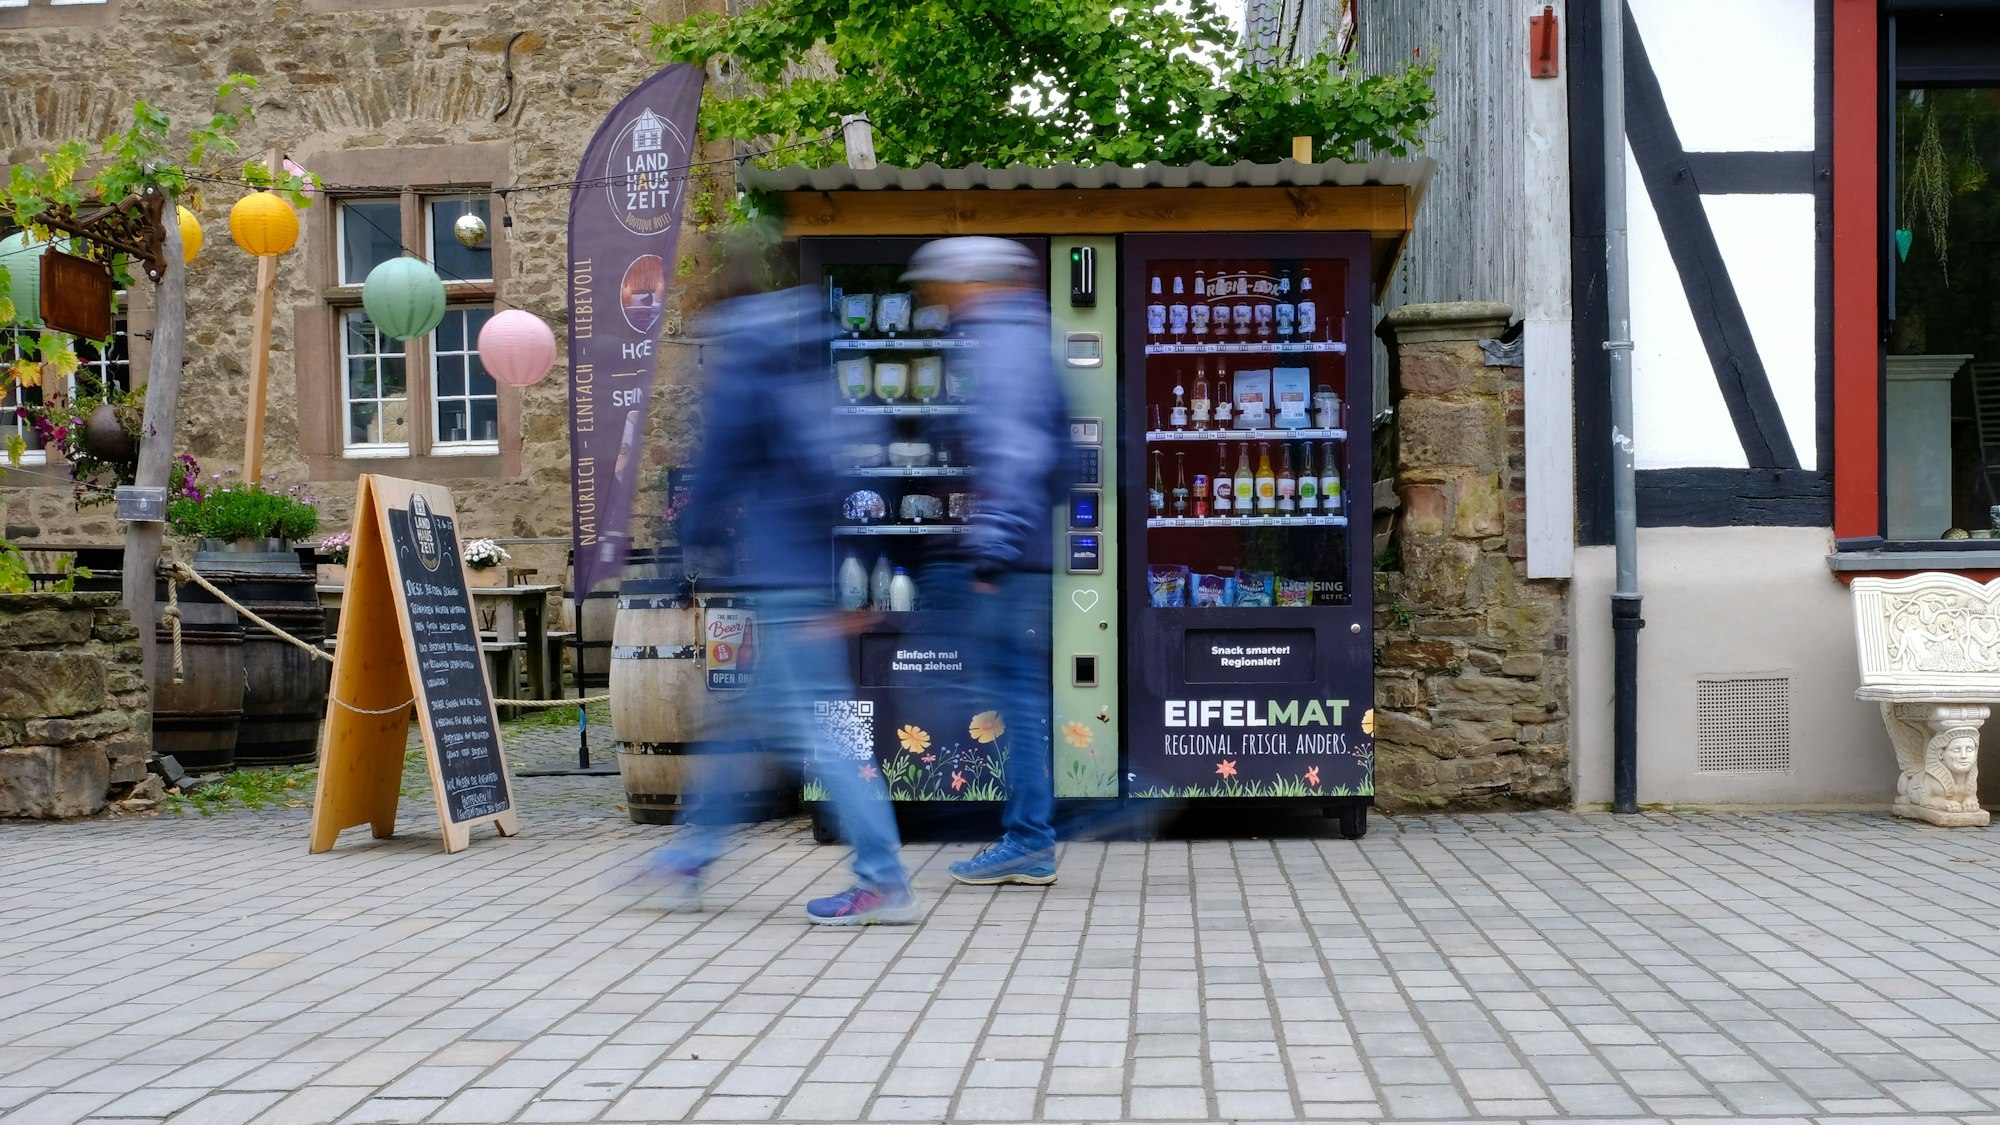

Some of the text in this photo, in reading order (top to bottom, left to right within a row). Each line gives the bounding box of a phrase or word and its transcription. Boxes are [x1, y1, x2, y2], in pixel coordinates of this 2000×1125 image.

[627, 152, 668, 172] LAND
[627, 171, 669, 191] HAUS
[627, 190, 669, 210] ZEIT
[666, 319, 682, 335] 81
[574, 257, 596, 547] NATÜRLICH EINFACH LIEBEVOLL
[414, 516, 430, 529] LAND
[417, 529, 433, 542] HAUS
[420, 542, 435, 554] ZEIT
[708, 620, 743, 638] Beer
[718, 645, 726, 653] IS
[897, 650, 958, 659] Einfach mal
[1211, 646, 1290, 655] Snack smarter!
[719, 652, 729, 660] AN
[1221, 657, 1281, 668] Regionaler!
[892, 661, 962, 672] blanq ziehen!
[713, 673, 735, 684] OPEN
[1165, 700, 1349, 726] EIFELMAT
[1165, 733, 1351, 755] REGIONAL. FRISCH. ANDERS.
